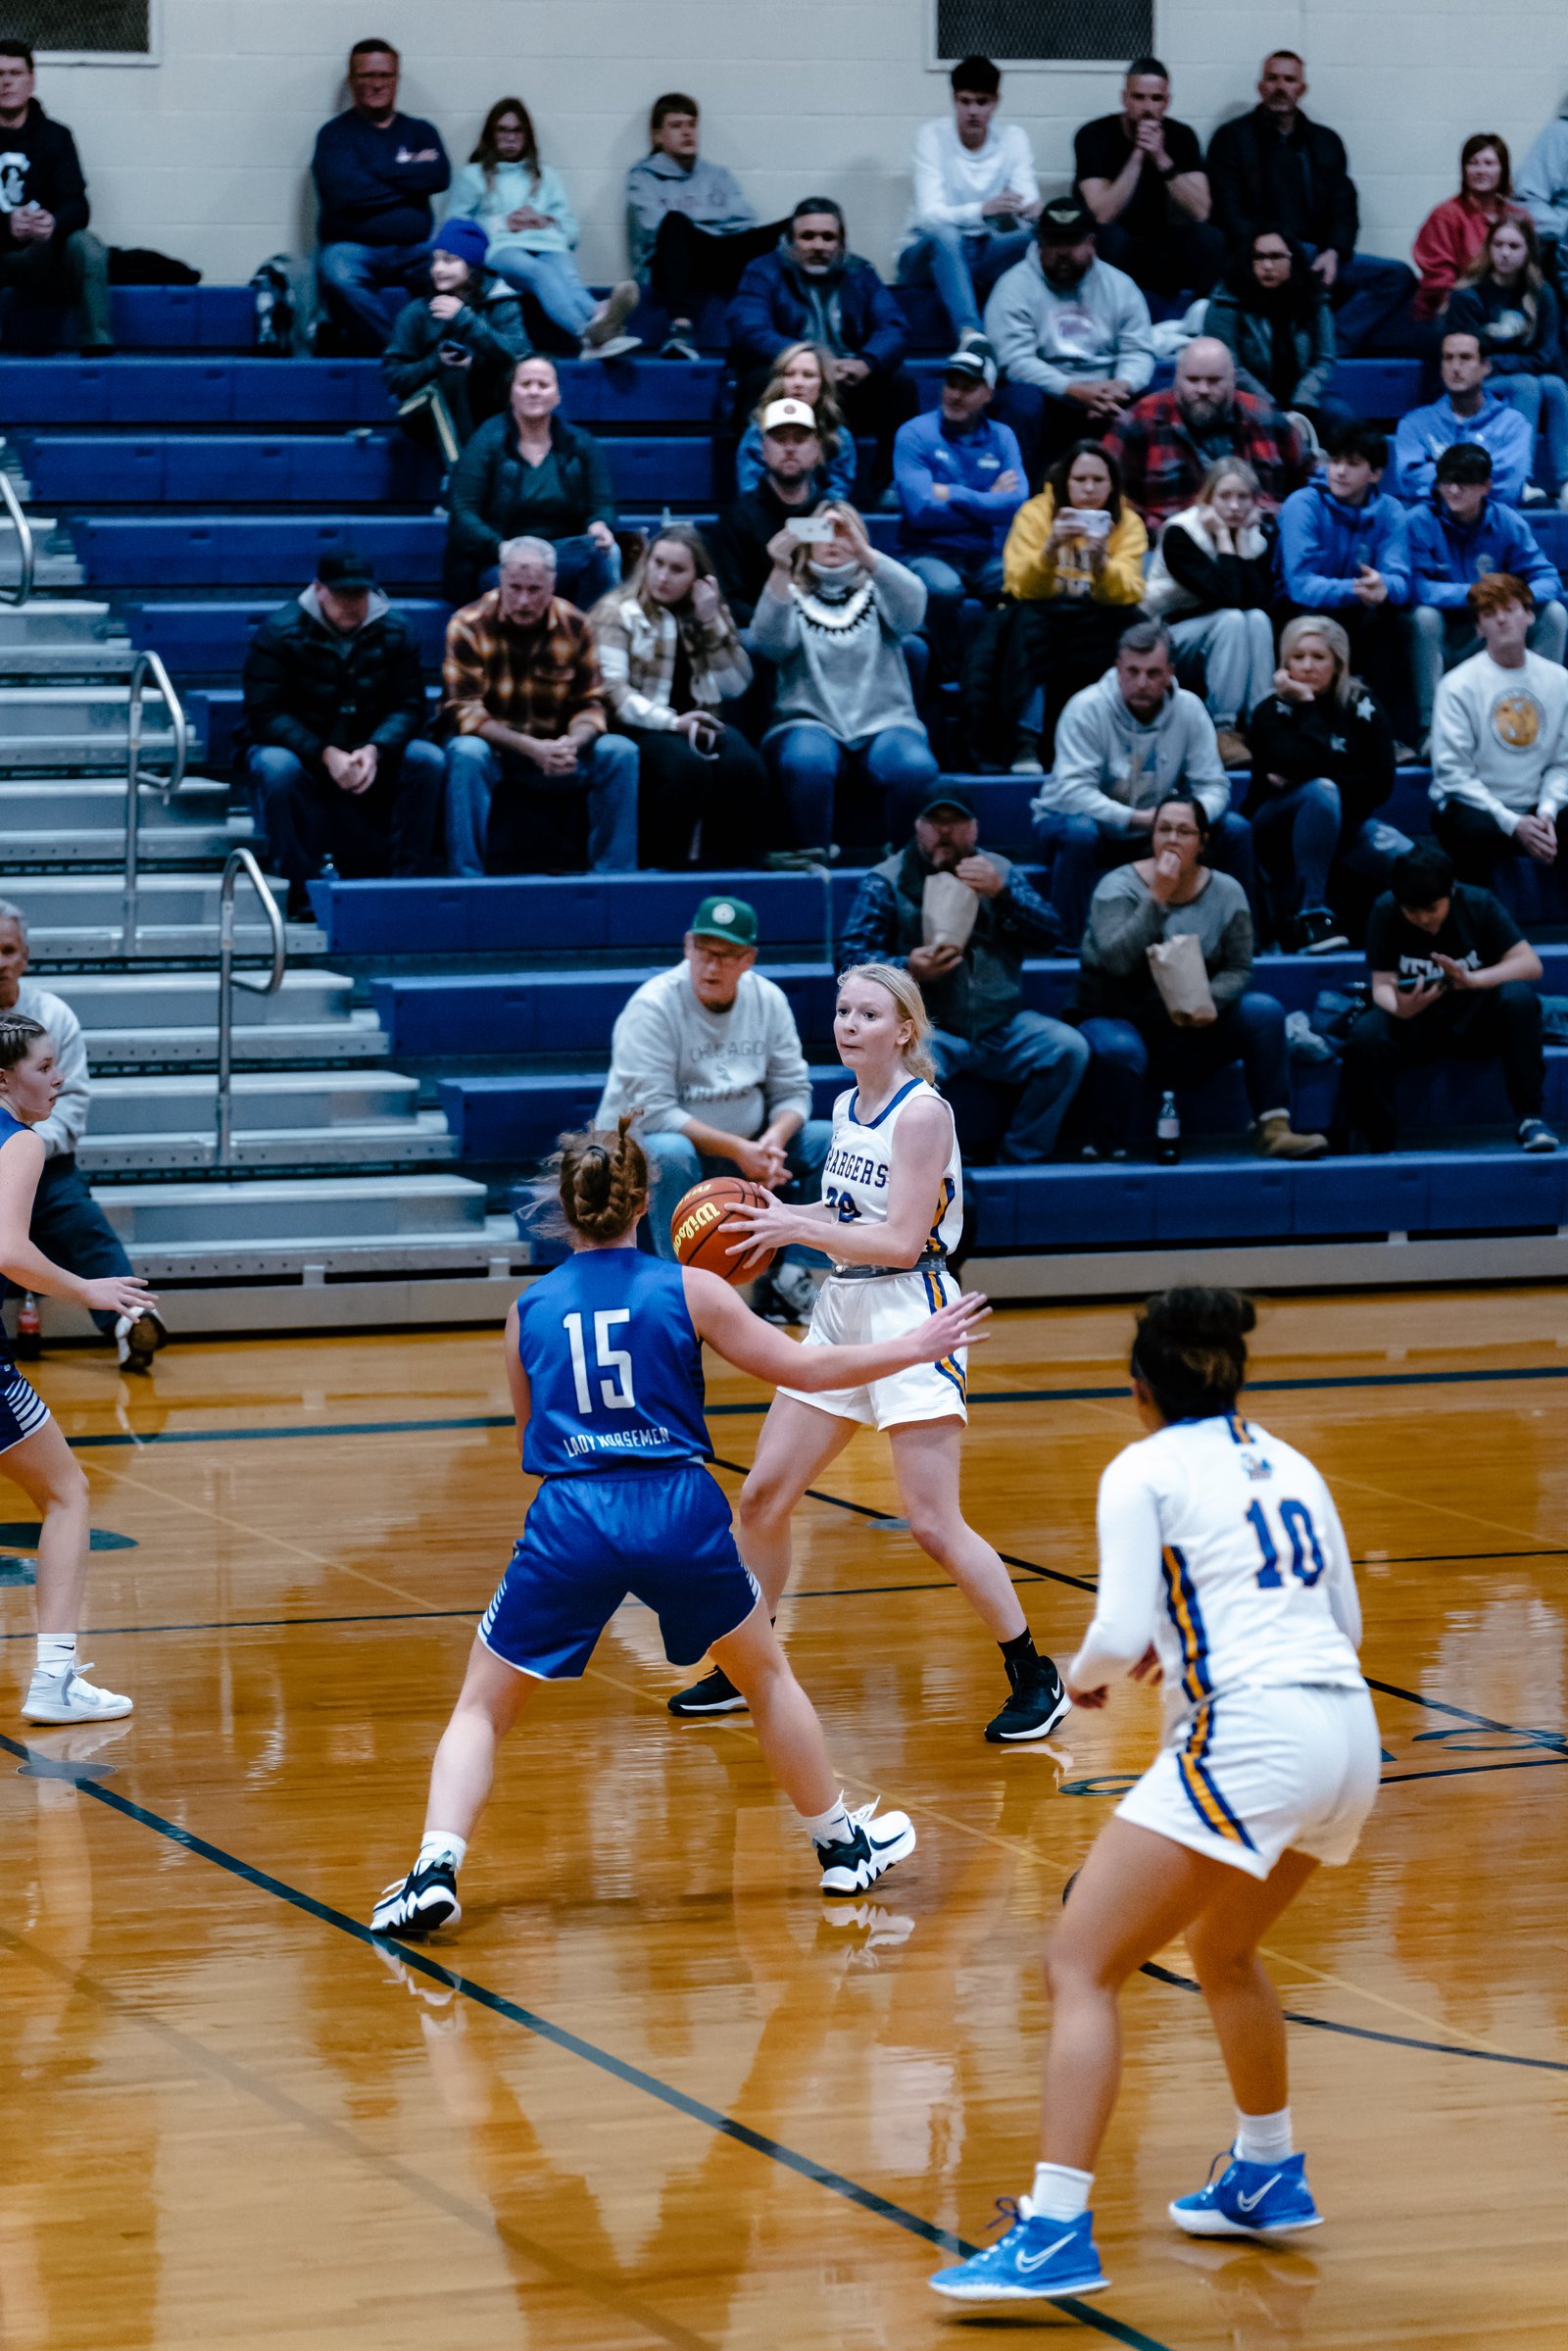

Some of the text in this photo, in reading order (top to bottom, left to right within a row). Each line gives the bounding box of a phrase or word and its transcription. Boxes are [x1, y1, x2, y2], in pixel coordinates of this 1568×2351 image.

[563, 1307, 636, 1414] 15
[563, 1434, 596, 1458] LADY
[1246, 1498, 1326, 1589] 10
